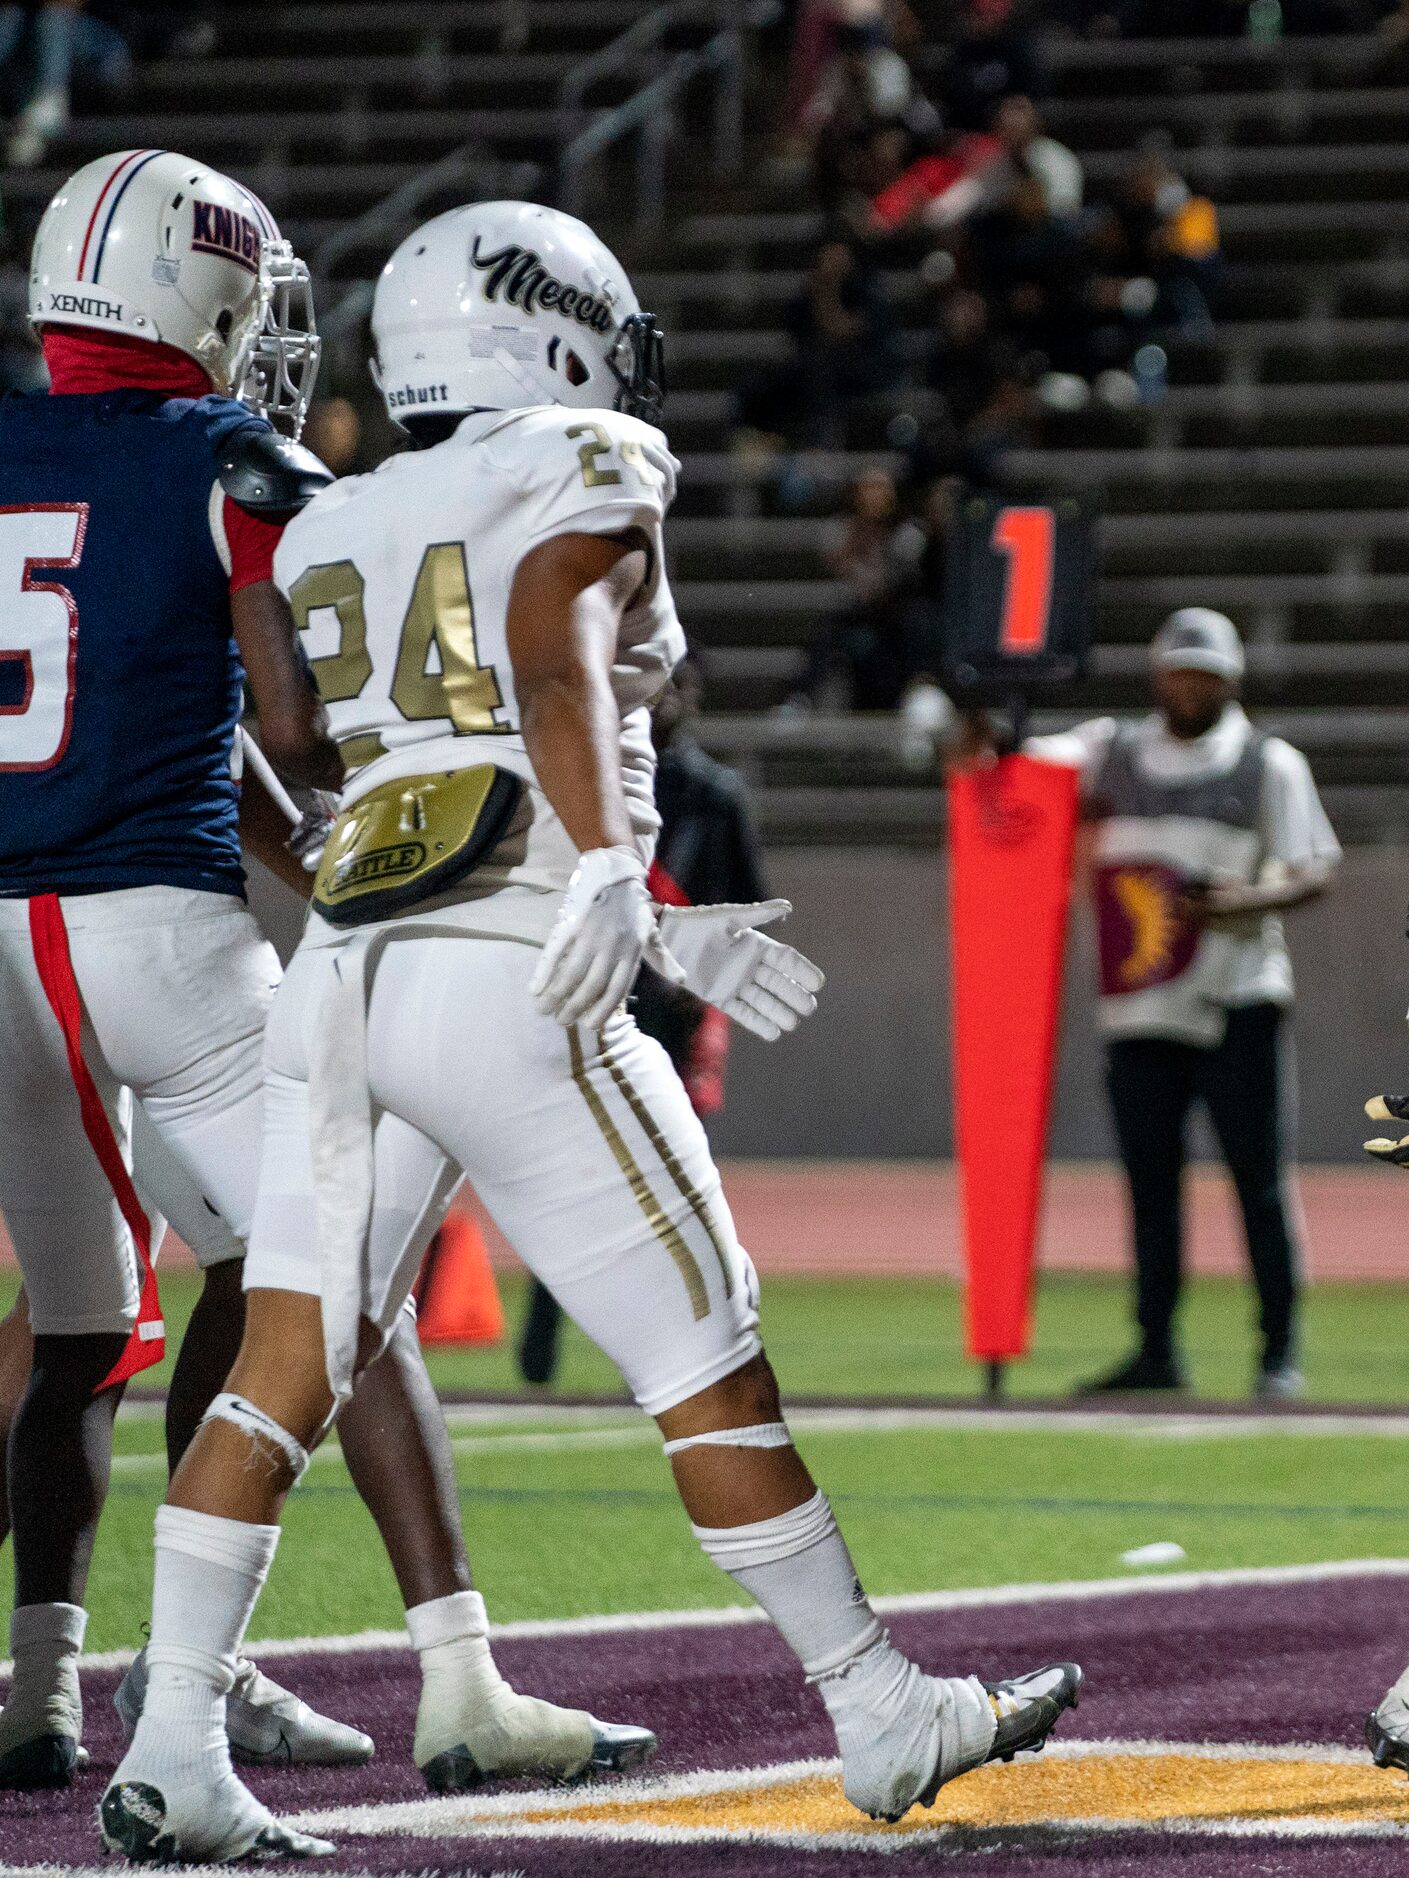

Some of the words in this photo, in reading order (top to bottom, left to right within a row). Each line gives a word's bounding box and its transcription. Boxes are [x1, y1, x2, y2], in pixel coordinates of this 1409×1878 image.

[50, 294, 124, 322] XENITH
[471, 234, 615, 337] Mecca
[387, 384, 448, 408] schutt
[993, 506, 1055, 655] 1
[288, 540, 521, 760] 24
[333, 848, 417, 887] ATTLE
